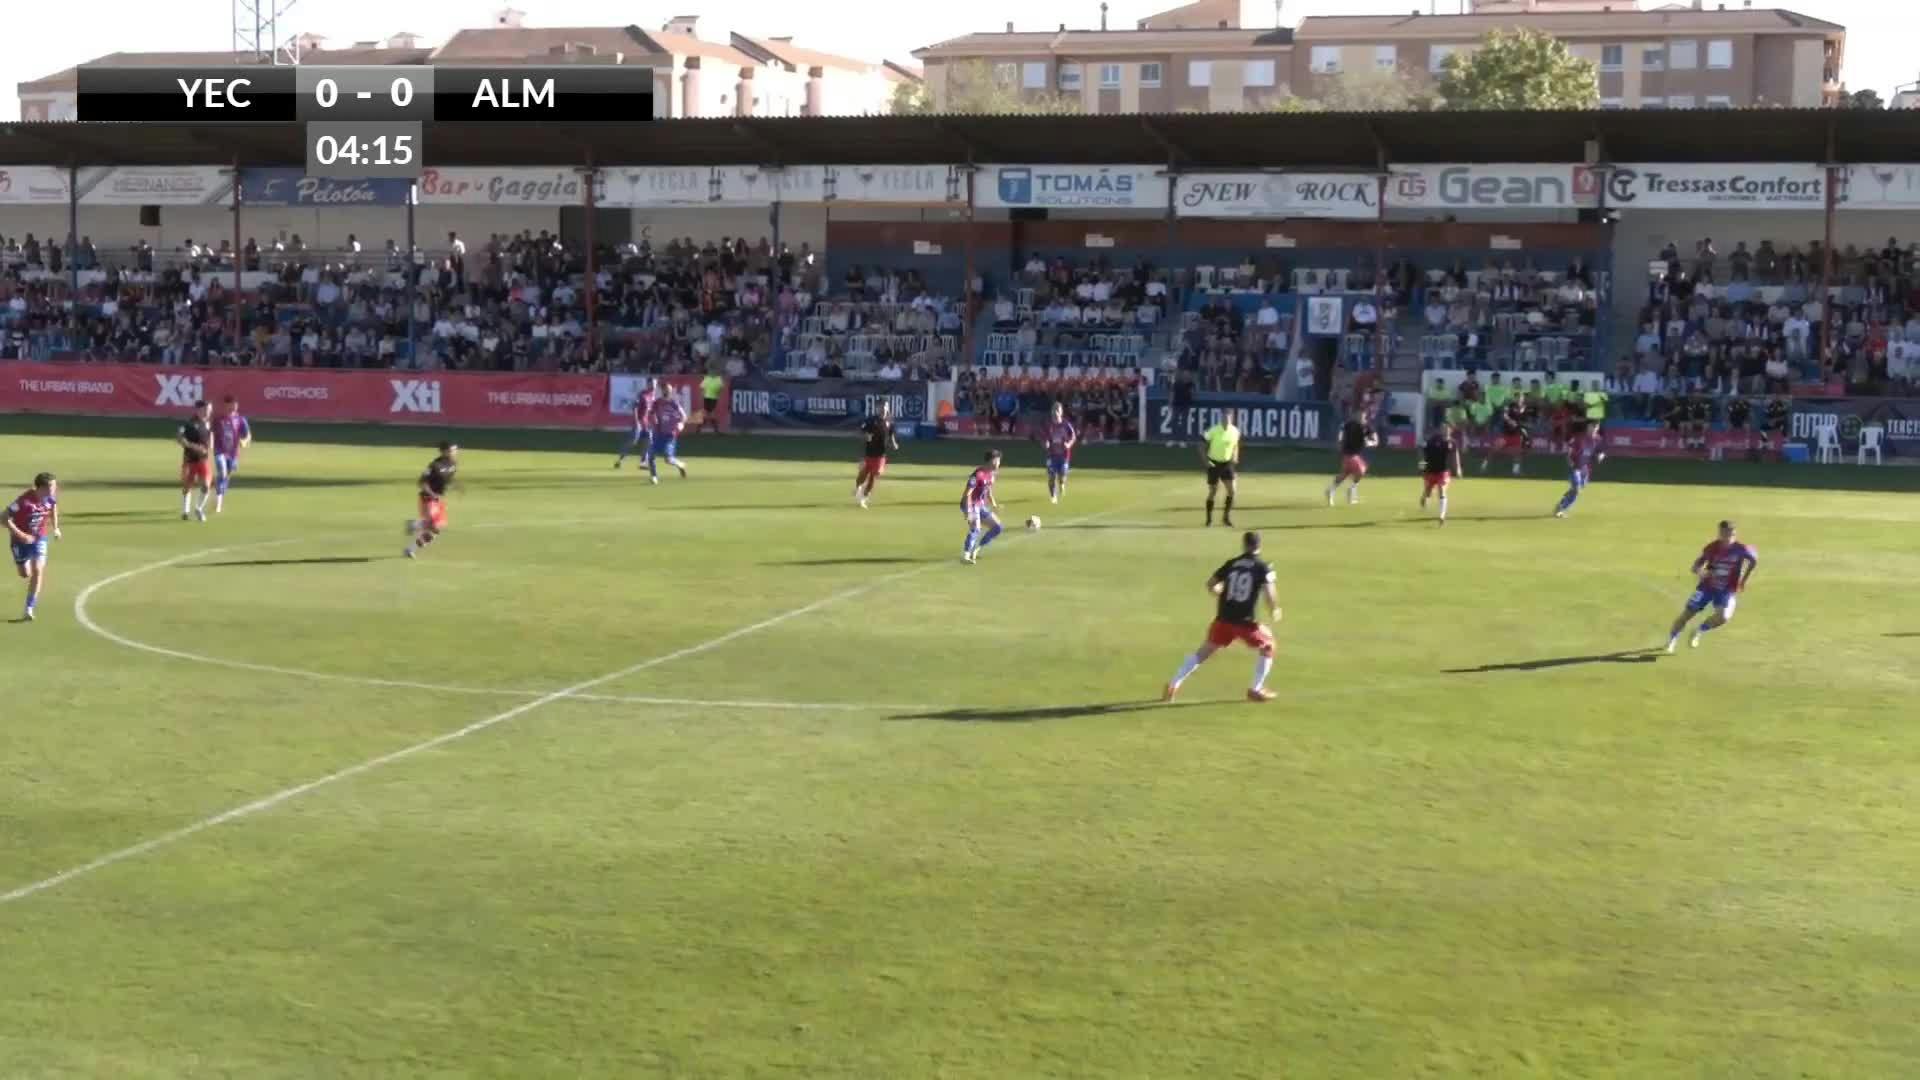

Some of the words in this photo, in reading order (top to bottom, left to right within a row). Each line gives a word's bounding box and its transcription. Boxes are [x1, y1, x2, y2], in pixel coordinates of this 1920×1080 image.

[296, 178, 375, 203] Pelotón
[422, 169, 469, 195] Bar
[488, 172, 577, 201] Gaggia
[1036, 168, 1133, 191] TOMÁS
[1440, 167, 1565, 204] Gean
[1644, 173, 1822, 195] TressasConfort
[1183, 182, 1256, 207] NEW
[1296, 182, 1376, 207] ROCK
[19, 379, 40, 391] THE
[41, 380, 75, 393] URBAN
[77, 381, 114, 394] BRAND
[155, 374, 203, 406] Xti
[390, 379, 440, 413] Xti
[488, 391, 509, 404] THE
[1187, 405, 1319, 438] FEDRACIÓN
[1226, 570, 1254, 602] 19
